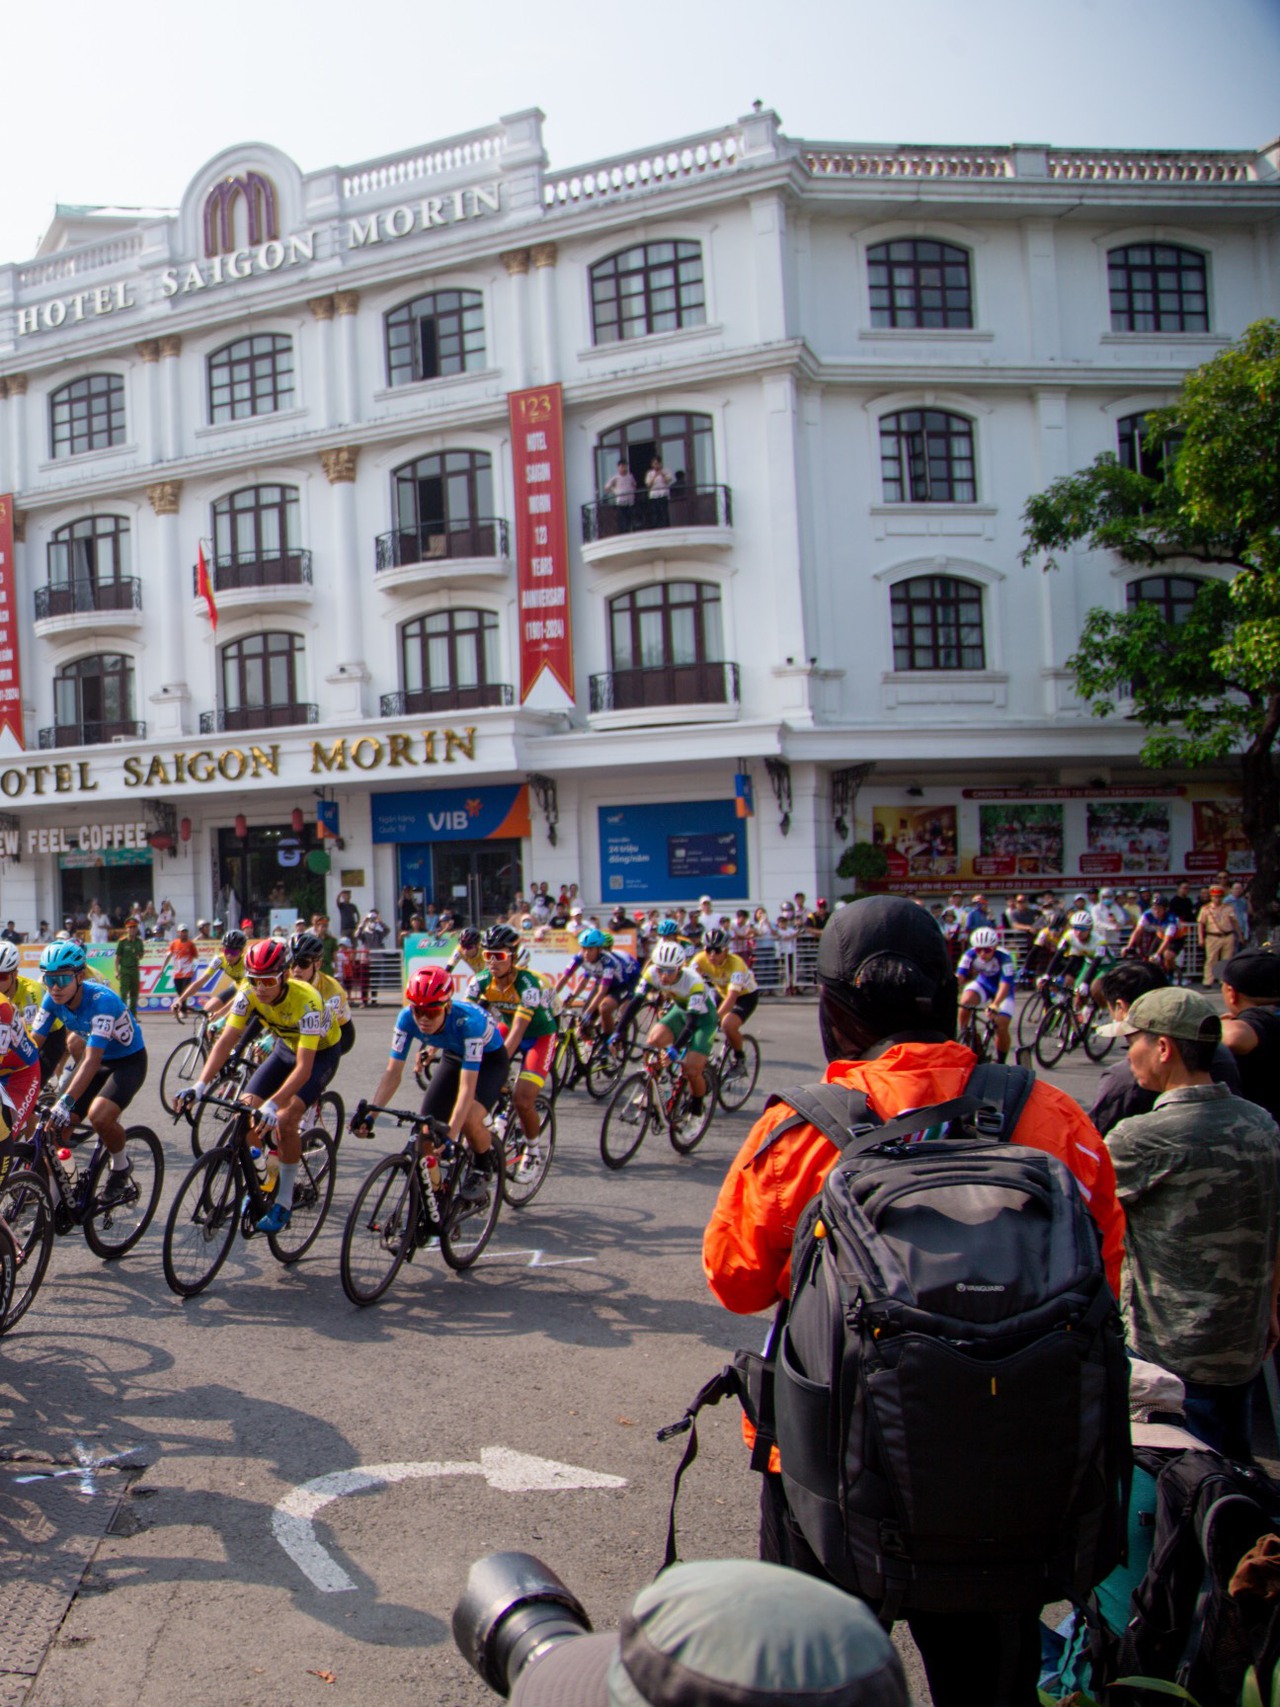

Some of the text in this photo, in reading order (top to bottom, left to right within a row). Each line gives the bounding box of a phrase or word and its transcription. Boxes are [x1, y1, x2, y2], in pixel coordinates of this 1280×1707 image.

[17, 181, 504, 336] HOTEL SAIGON MORIN
[520, 394, 551, 417] 123
[123, 744, 281, 787] SAIGON
[309, 726, 477, 773] MORIN
[428, 811, 469, 831] VIB
[27, 827, 69, 854] FEEL
[78, 822, 148, 851] COFFEE
[87, 949, 115, 957] HTV
[418, 938, 449, 948] HTV
[97, 1018, 111, 1032] 75
[115, 1014, 133, 1044] 75
[302, 1015, 319, 1029] 105
